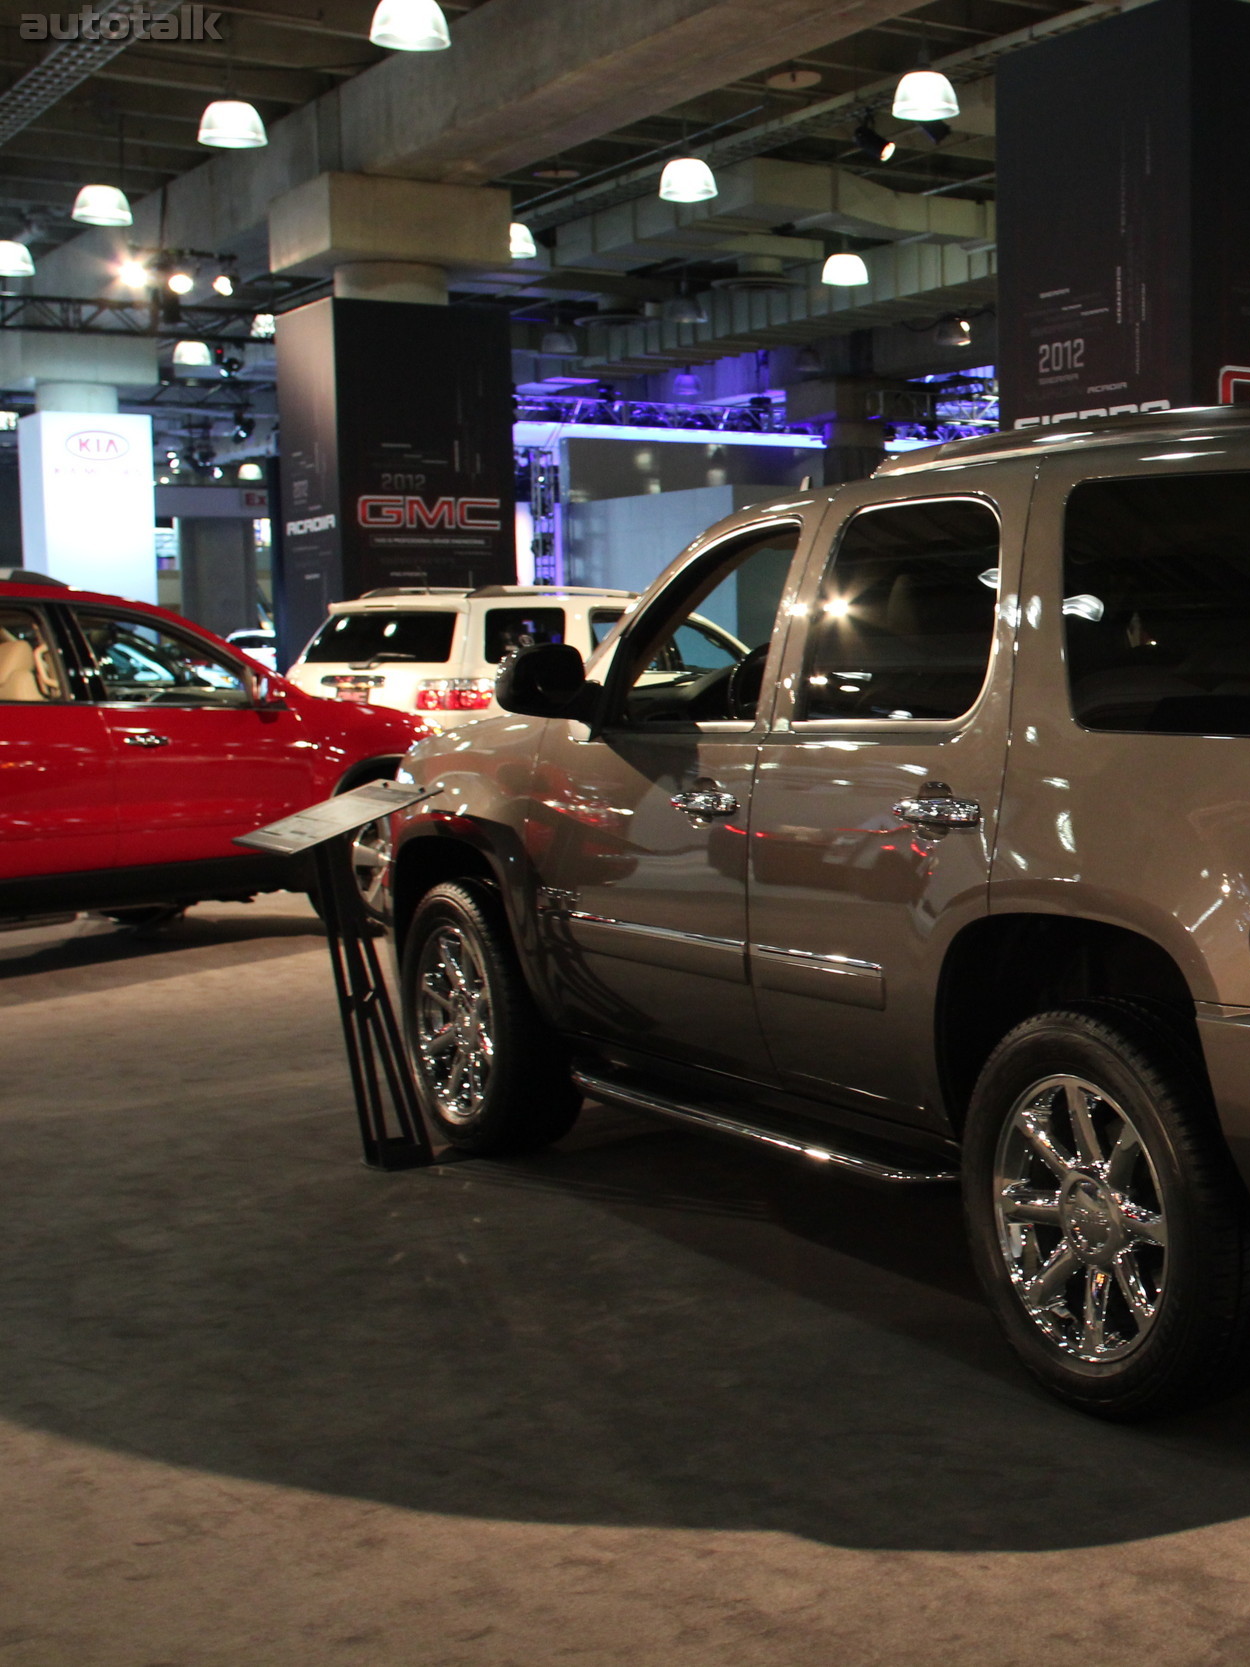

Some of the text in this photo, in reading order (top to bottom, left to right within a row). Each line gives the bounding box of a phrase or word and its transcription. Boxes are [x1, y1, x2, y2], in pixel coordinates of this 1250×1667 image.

[1038, 338, 1085, 374] 2012
[78, 438, 119, 453] KIA
[381, 473, 427, 492] 2012
[357, 494, 501, 531] GMC
[286, 514, 336, 536] ACADIA
